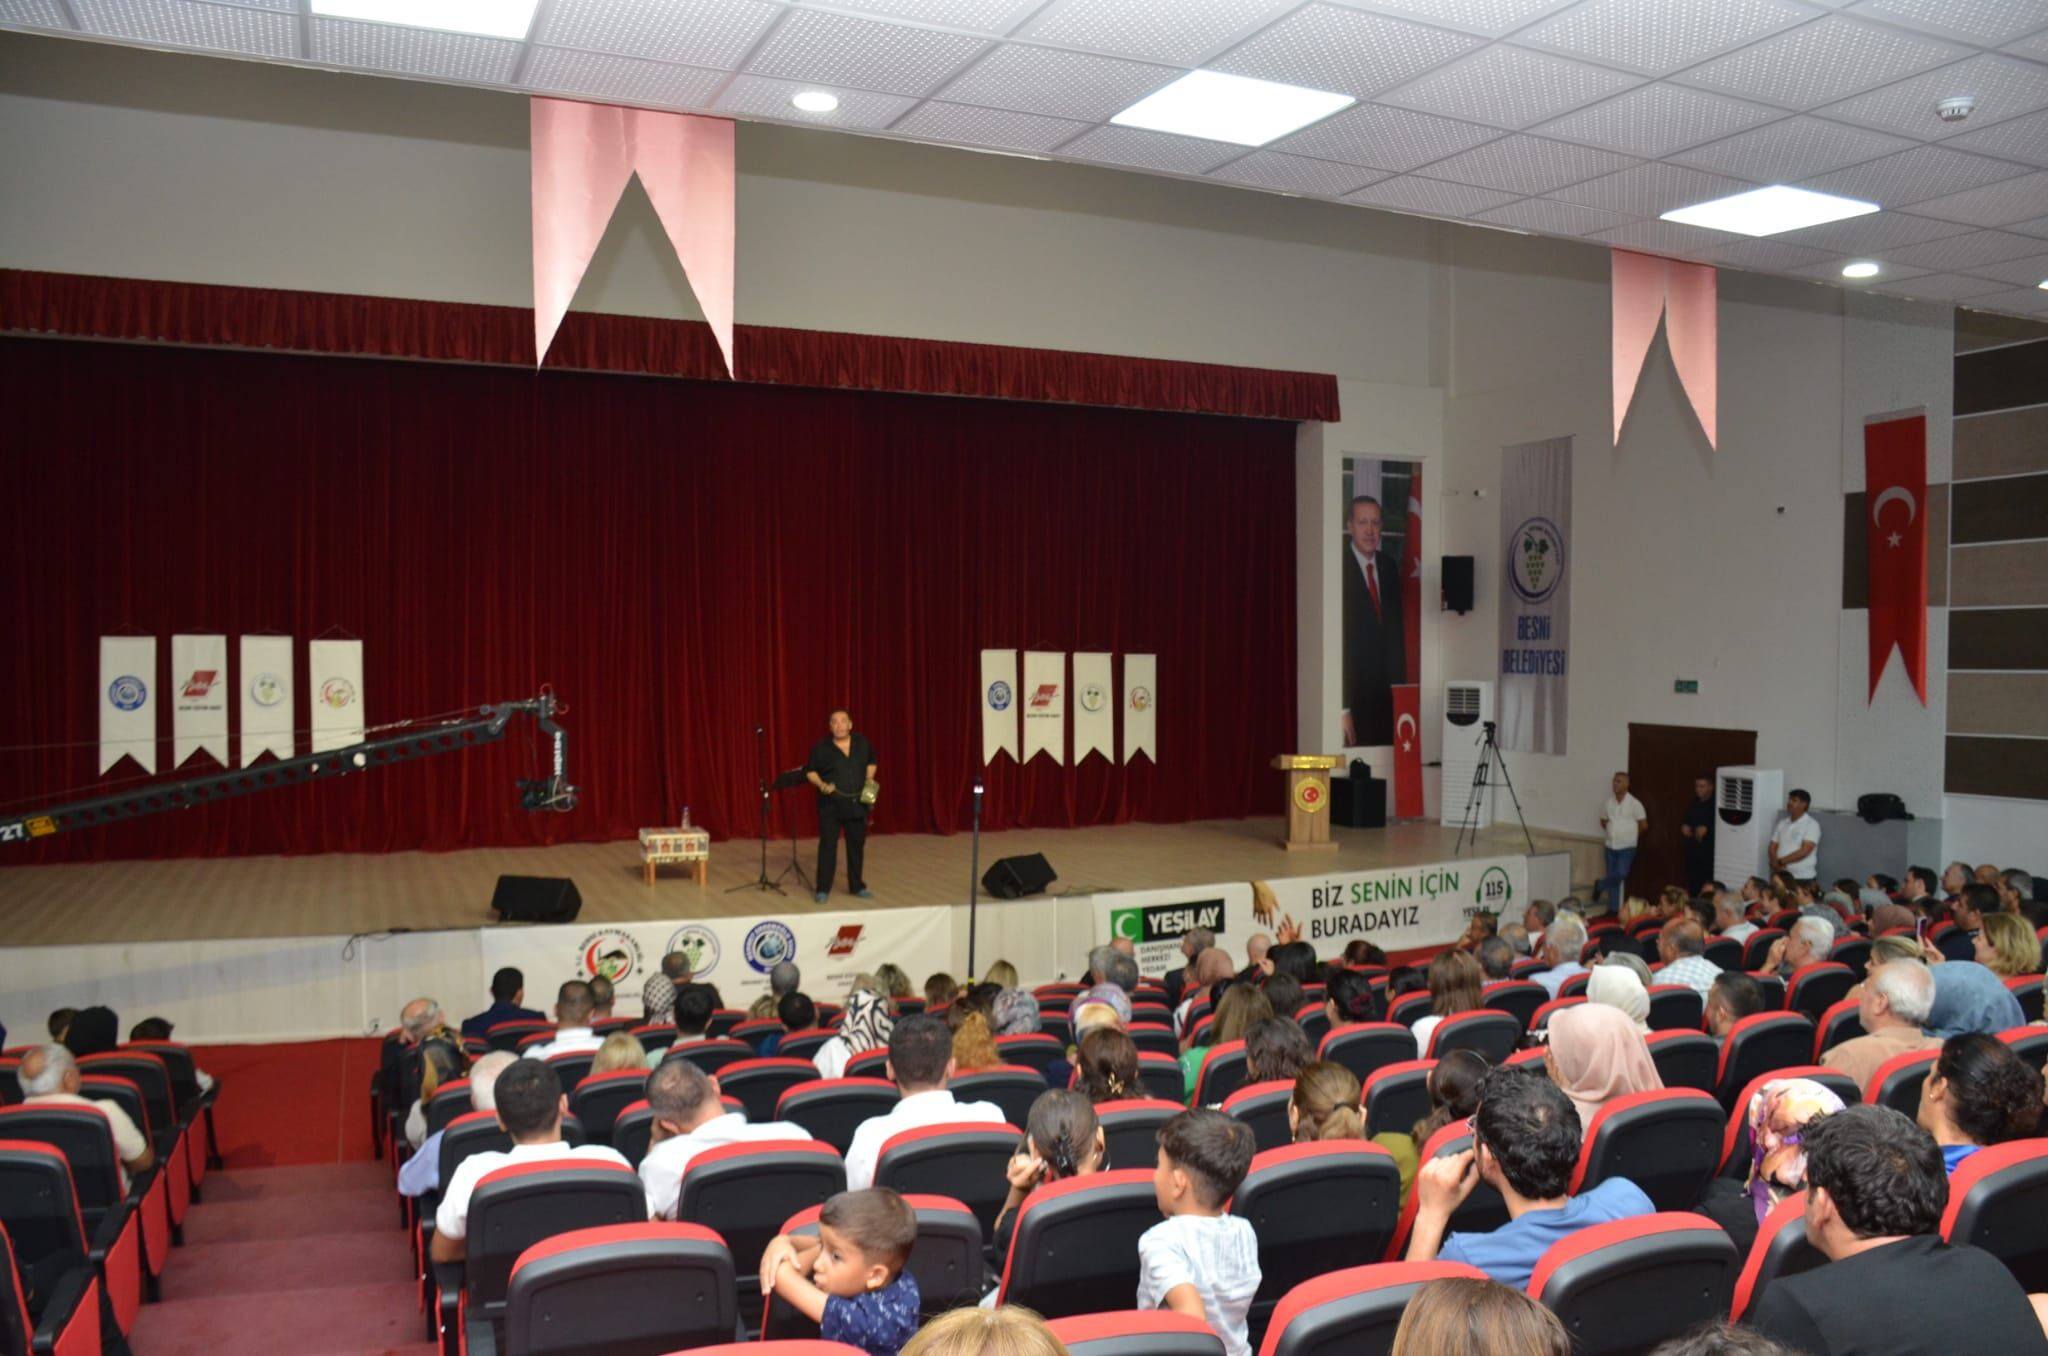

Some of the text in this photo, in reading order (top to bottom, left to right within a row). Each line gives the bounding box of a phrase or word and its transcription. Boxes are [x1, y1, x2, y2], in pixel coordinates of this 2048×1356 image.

[1517, 616, 1552, 640] BESNİ
[1503, 649, 1566, 675] BELEDİYESİ
[1312, 867, 1459, 909] BİZ SENİN İÇİN
[1485, 880, 1504, 897] 115
[1148, 906, 1220, 935] YEŞİLAY
[1311, 906, 1419, 939] BURADAYIZ
